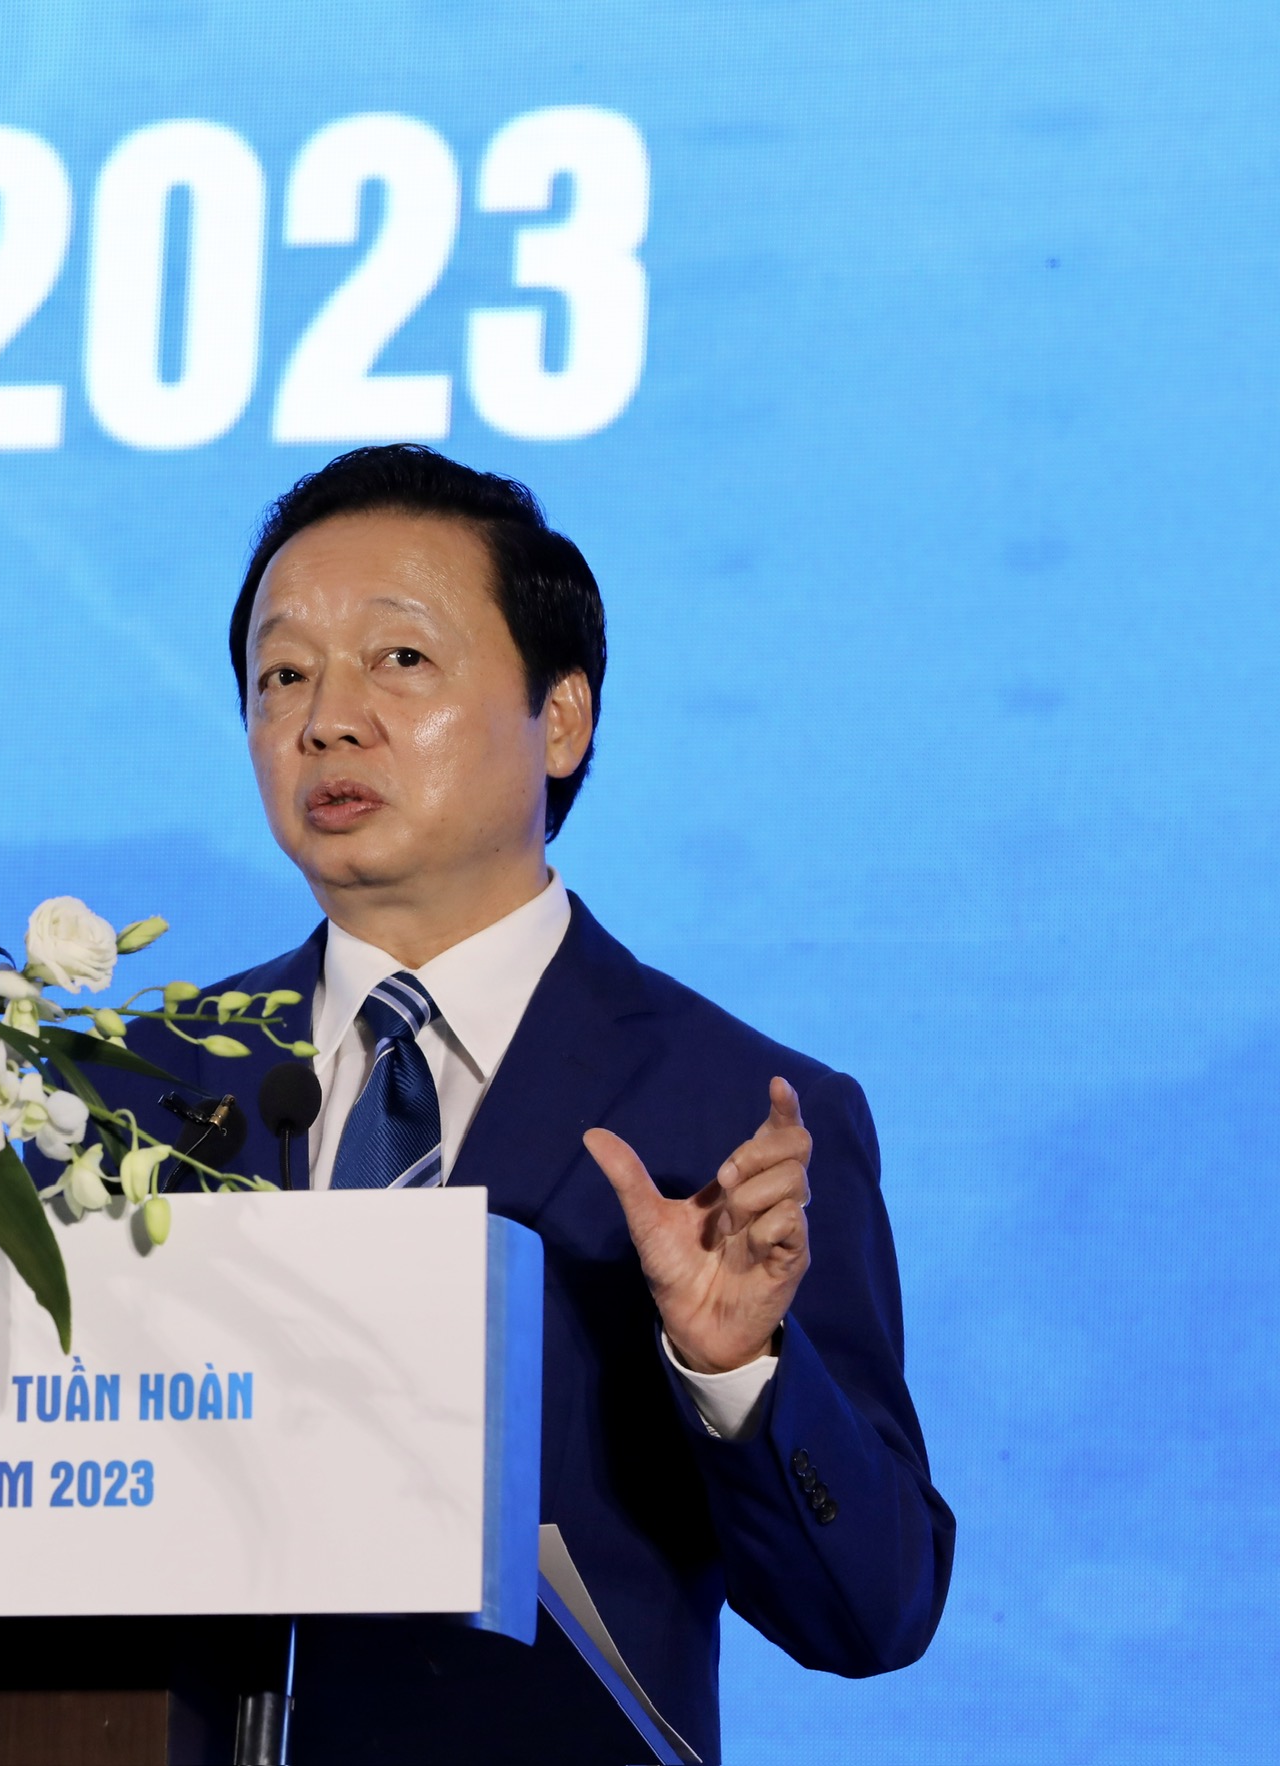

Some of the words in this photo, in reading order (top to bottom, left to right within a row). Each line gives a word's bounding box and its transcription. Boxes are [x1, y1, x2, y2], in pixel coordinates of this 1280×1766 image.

[12, 1356, 121, 1423] TUẦN
[139, 1362, 254, 1421] HOÀN
[49, 1459, 155, 1507] 2023
